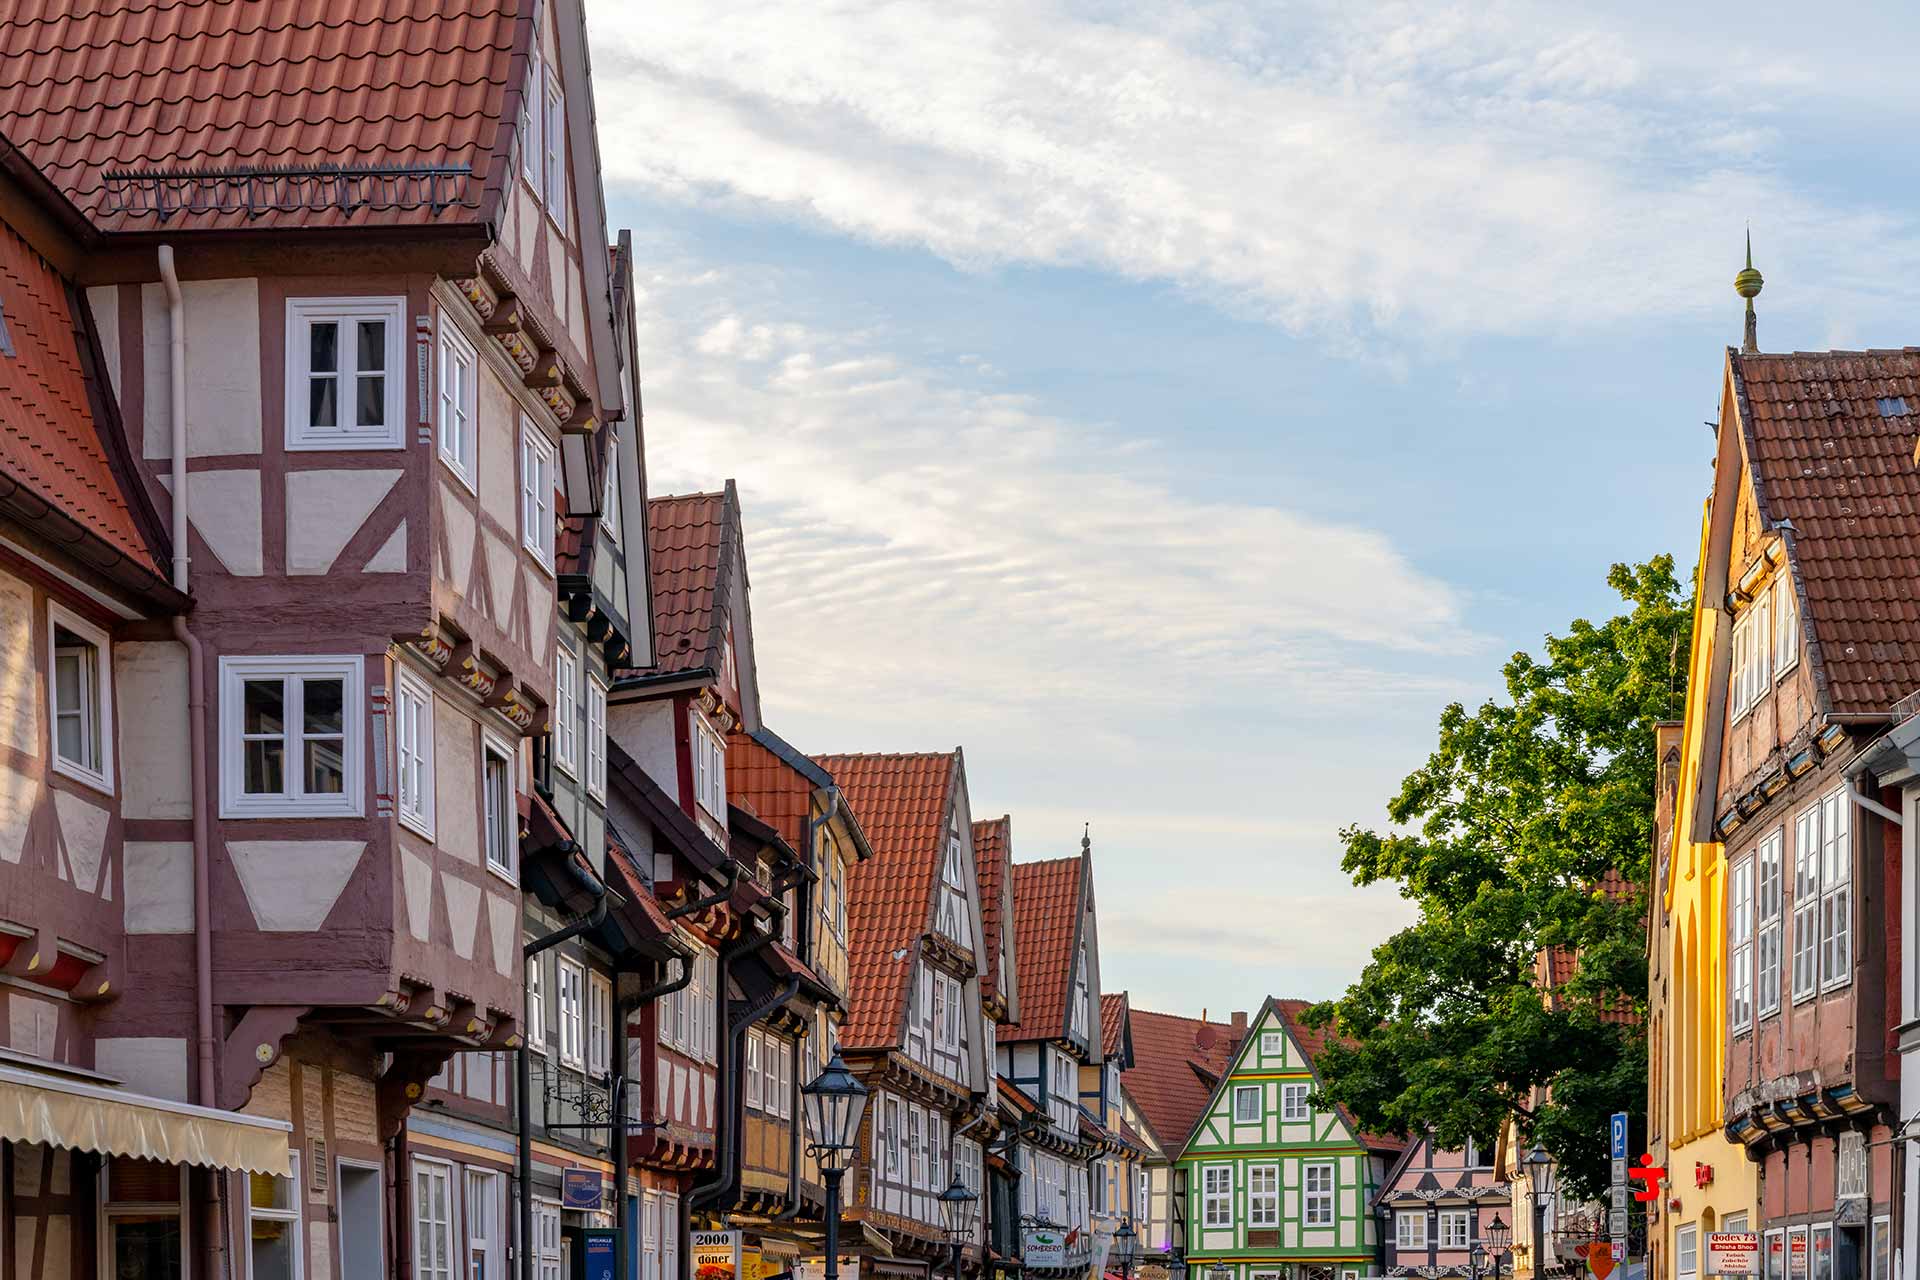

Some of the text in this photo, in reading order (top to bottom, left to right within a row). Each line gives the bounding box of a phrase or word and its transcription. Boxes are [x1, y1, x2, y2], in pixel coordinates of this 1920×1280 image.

[696, 1234, 729, 1246] 2000
[1711, 1233, 1756, 1242] Qodex 73
[698, 1254, 730, 1264] döner
